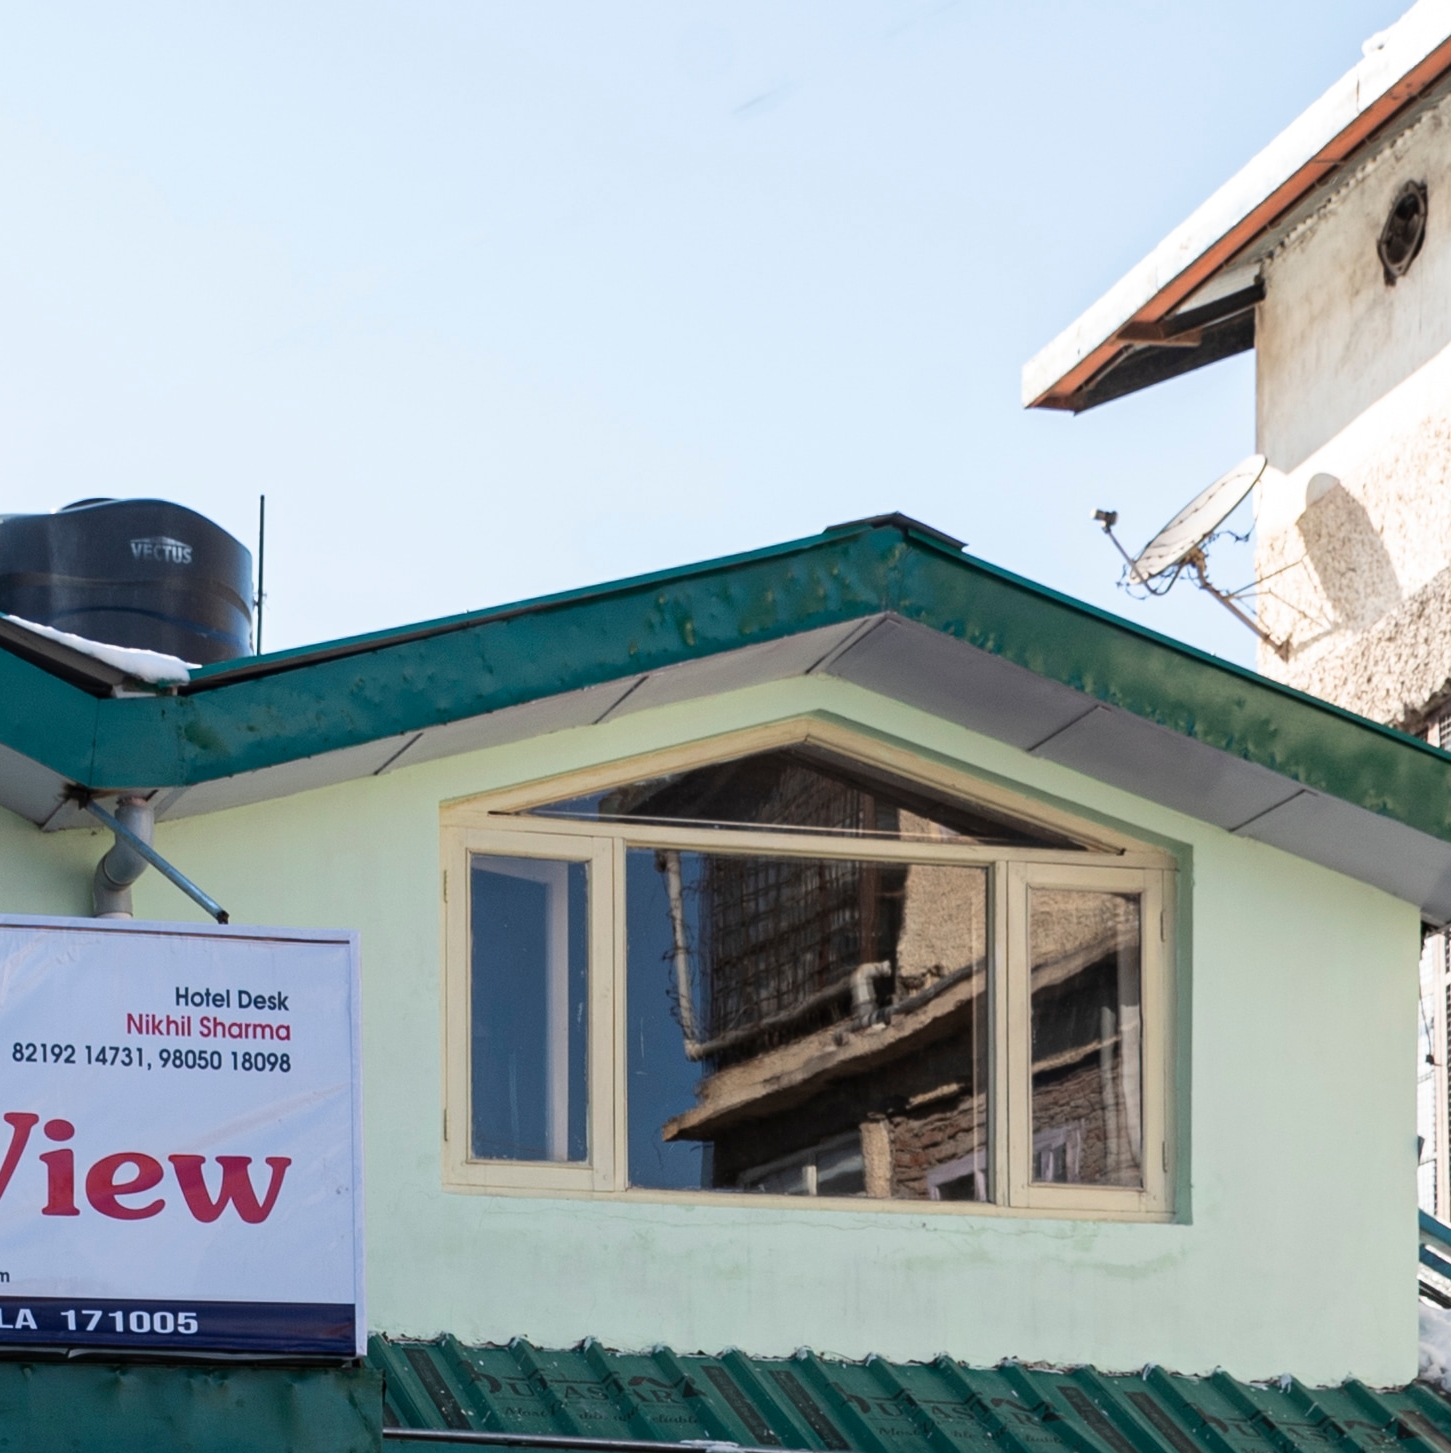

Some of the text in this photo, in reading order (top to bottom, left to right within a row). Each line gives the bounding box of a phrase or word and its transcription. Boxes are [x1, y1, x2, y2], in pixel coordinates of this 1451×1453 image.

[175, 986, 290, 1011] Hotel Desk
[126, 1013, 291, 1041] Nikhil Sharma
[12, 1042, 292, 1073] 82192 14731, 98050 18098
[60, 1309, 199, 1334] 171005
